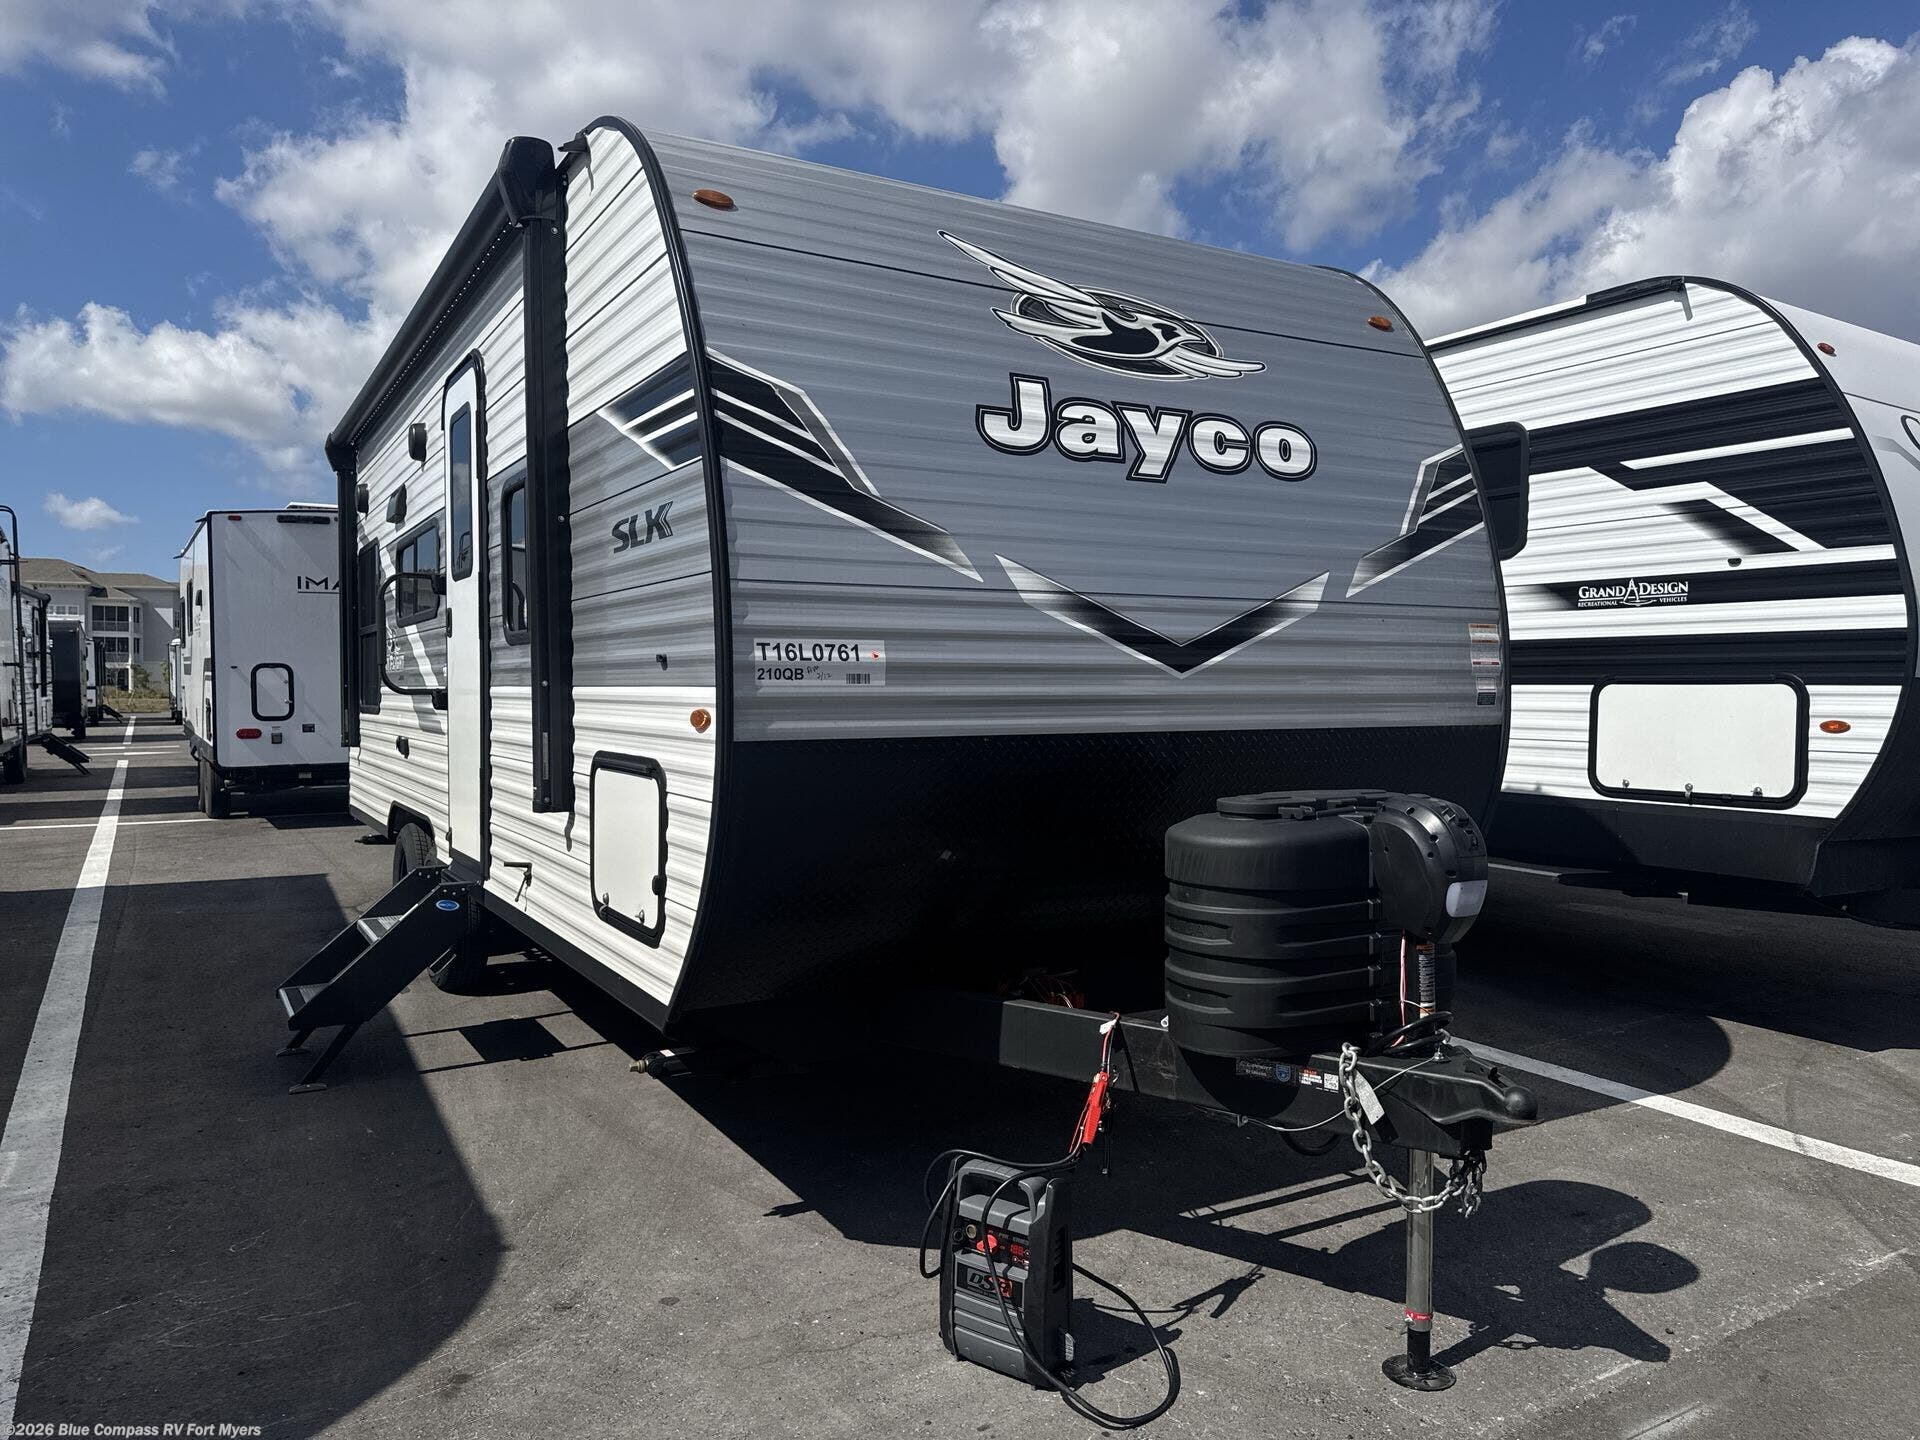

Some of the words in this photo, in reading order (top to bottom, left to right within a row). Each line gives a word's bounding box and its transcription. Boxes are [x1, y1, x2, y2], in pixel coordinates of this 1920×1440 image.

[975, 372, 1318, 484] Jayco
[611, 500, 674, 554] SLK
[1577, 586, 1626, 599] GRAND
[1639, 581, 1688, 595] DESIGN
[1577, 600, 1618, 608] RECREATIONAL
[1659, 596, 1688, 604] VEHICLES
[756, 641, 861, 662] T16L0761
[756, 667, 805, 681] 210QB
